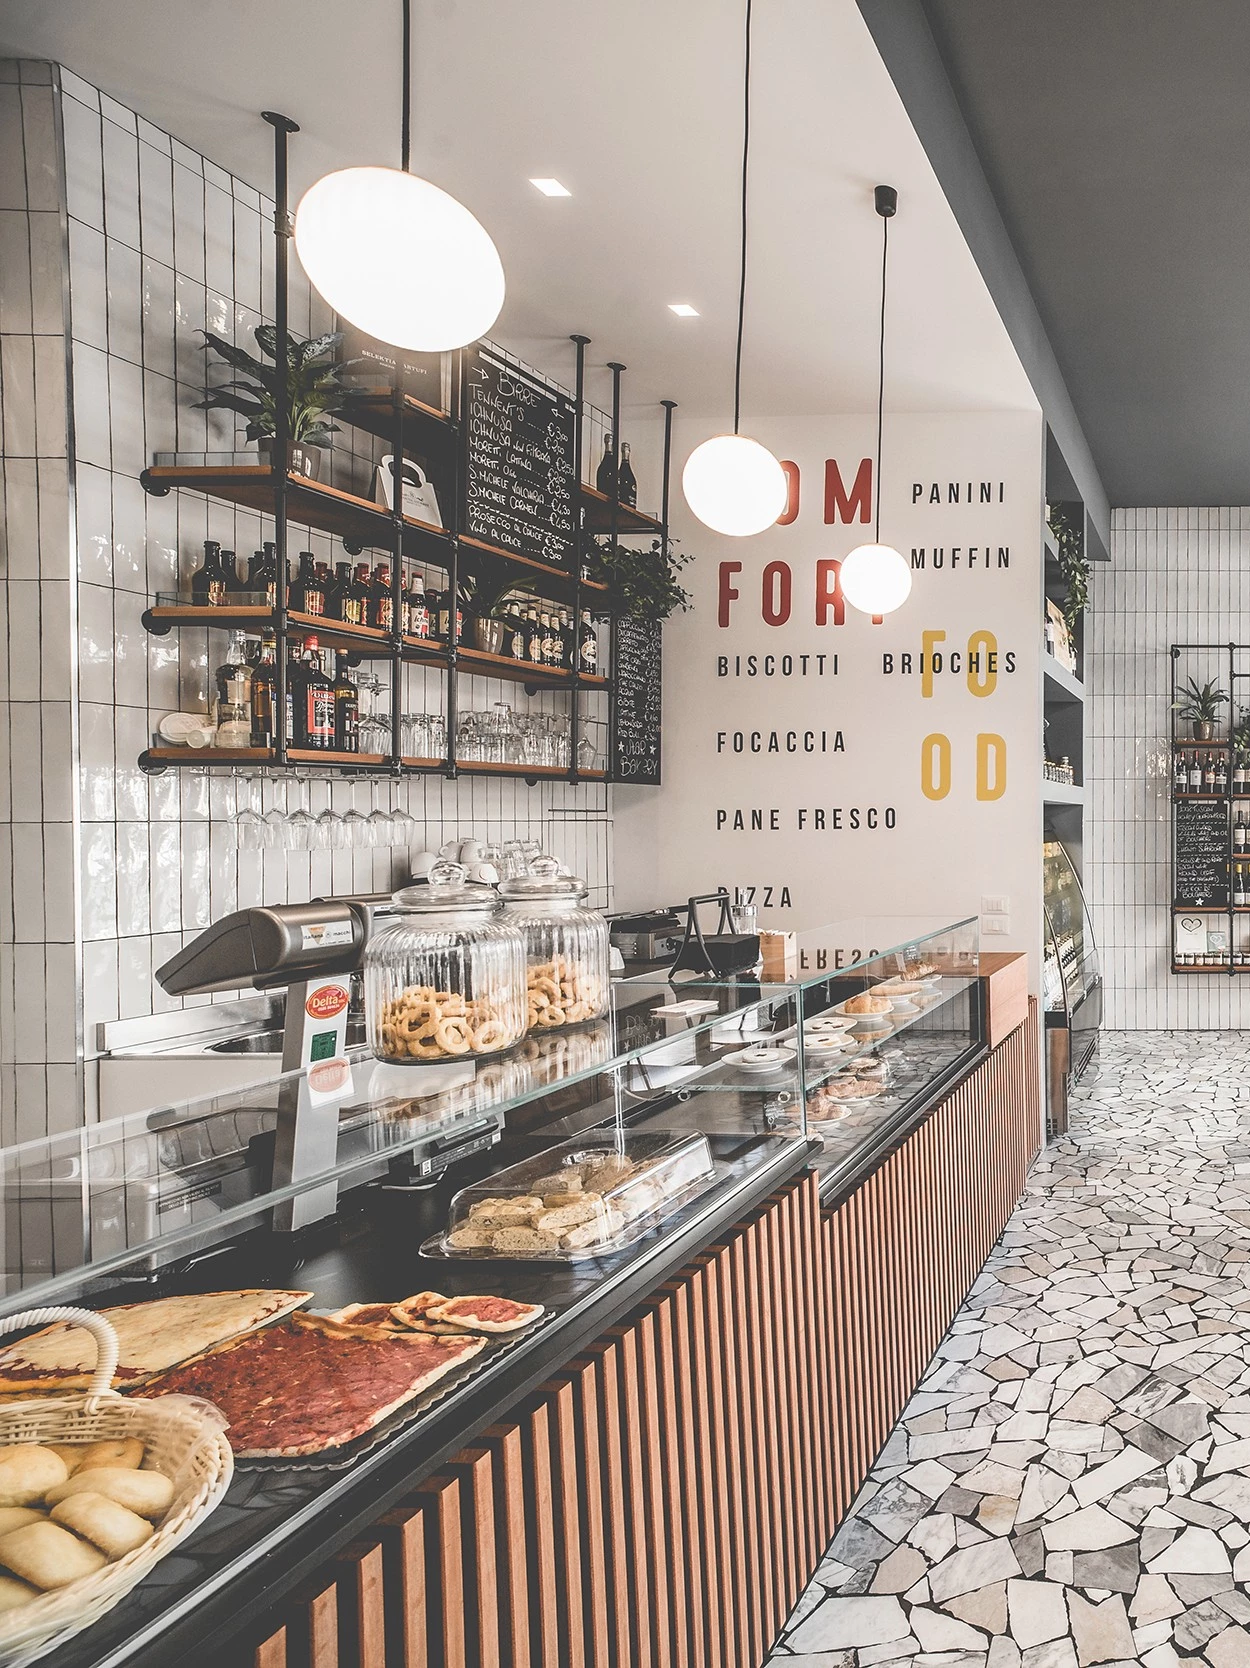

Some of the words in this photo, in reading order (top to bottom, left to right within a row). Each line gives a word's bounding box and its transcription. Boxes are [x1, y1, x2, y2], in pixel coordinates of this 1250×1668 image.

[362, 349, 397, 365] SELEKTIA
[497, 371, 541, 408] BIRRE
[469, 402, 512, 432] ICHNUSA
[469, 418, 511, 447] ICHNUSA
[912, 482, 1005, 504] PANINI
[468, 504, 512, 530] PROSECCO
[910, 547, 1011, 570] MUFFIN
[718, 559, 884, 628] FOR
[717, 653, 840, 677] BISCOTTI
[881, 651, 1017, 674] BRIOCHES
[921, 629, 998, 698] FO
[717, 731, 846, 754] FOCACCIA
[921, 733, 1007, 801] OD
[716, 808, 781, 831] PANE
[797, 807, 898, 831] FRESCO
[312, 996, 338, 1008] Delta
